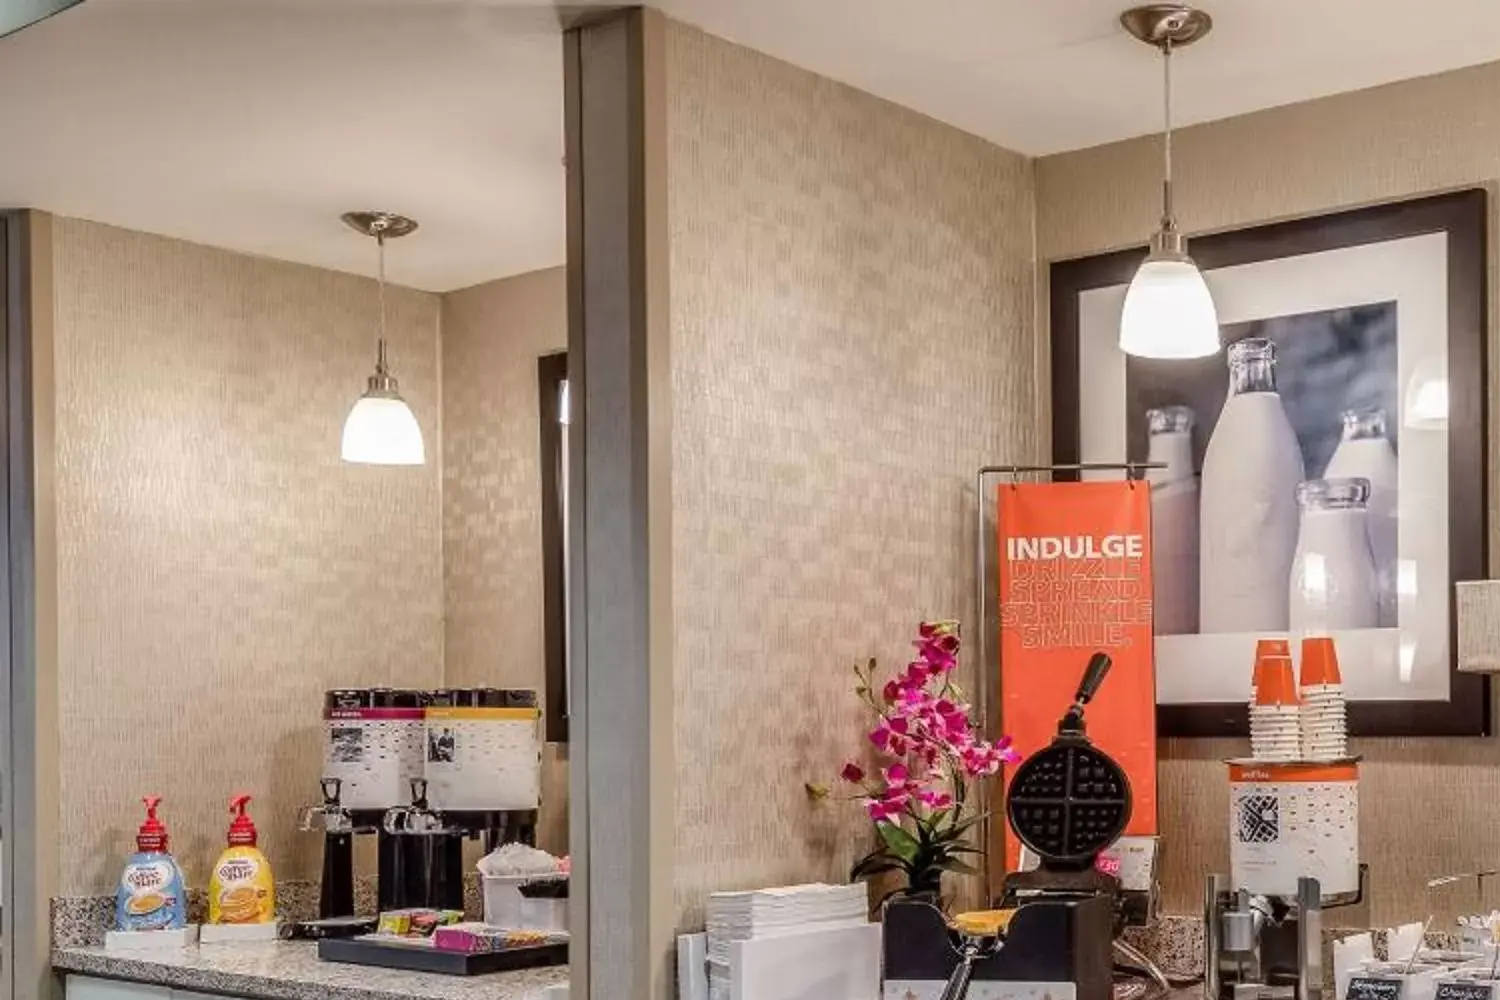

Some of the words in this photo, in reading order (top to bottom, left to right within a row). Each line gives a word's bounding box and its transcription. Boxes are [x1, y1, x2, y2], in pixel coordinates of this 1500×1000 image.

[1007, 535, 1143, 560] INDULGE
[1009, 559, 1142, 581] DRIZZLE
[1009, 579, 1143, 604] SPREAD
[1000, 601, 1152, 627] SPRINKLE
[1023, 625, 1132, 649] SMILE.
